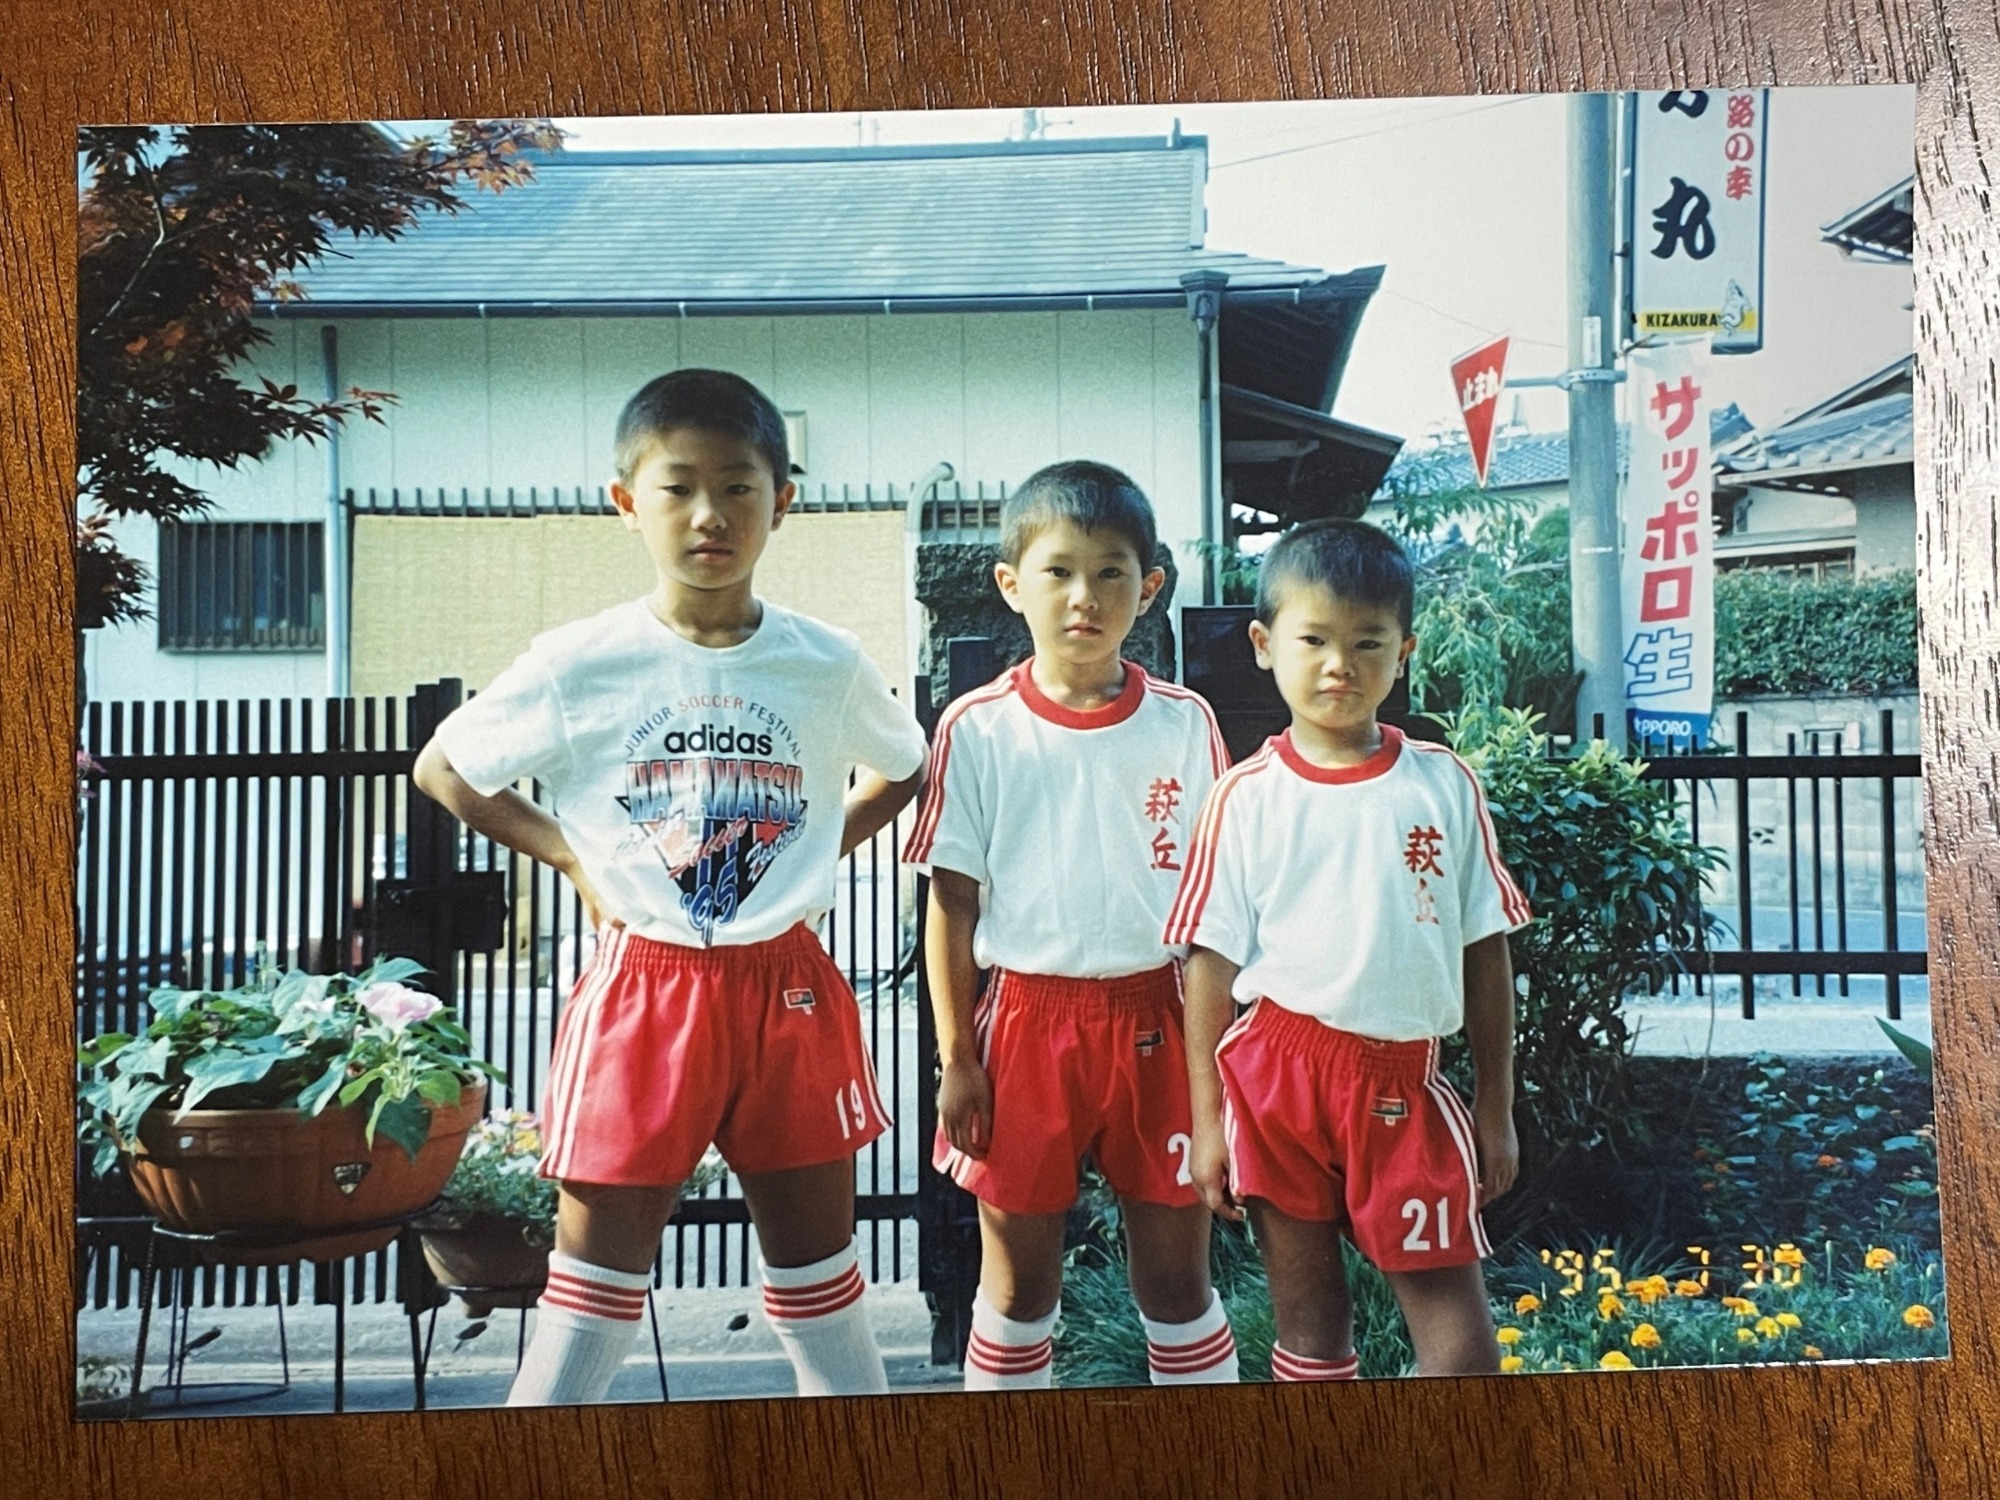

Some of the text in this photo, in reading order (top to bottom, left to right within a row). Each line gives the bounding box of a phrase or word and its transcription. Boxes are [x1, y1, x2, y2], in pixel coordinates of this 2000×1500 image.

[1646, 312, 1718, 328] KIZAKURA
[1463, 365, 1500, 412] 止まれ
[624, 694, 802, 763] JUNIOR SOCCER FESTIVAL
[663, 723, 774, 757] adidas
[835, 1078, 867, 1141] 19
[1401, 1197, 1451, 1252] 21
